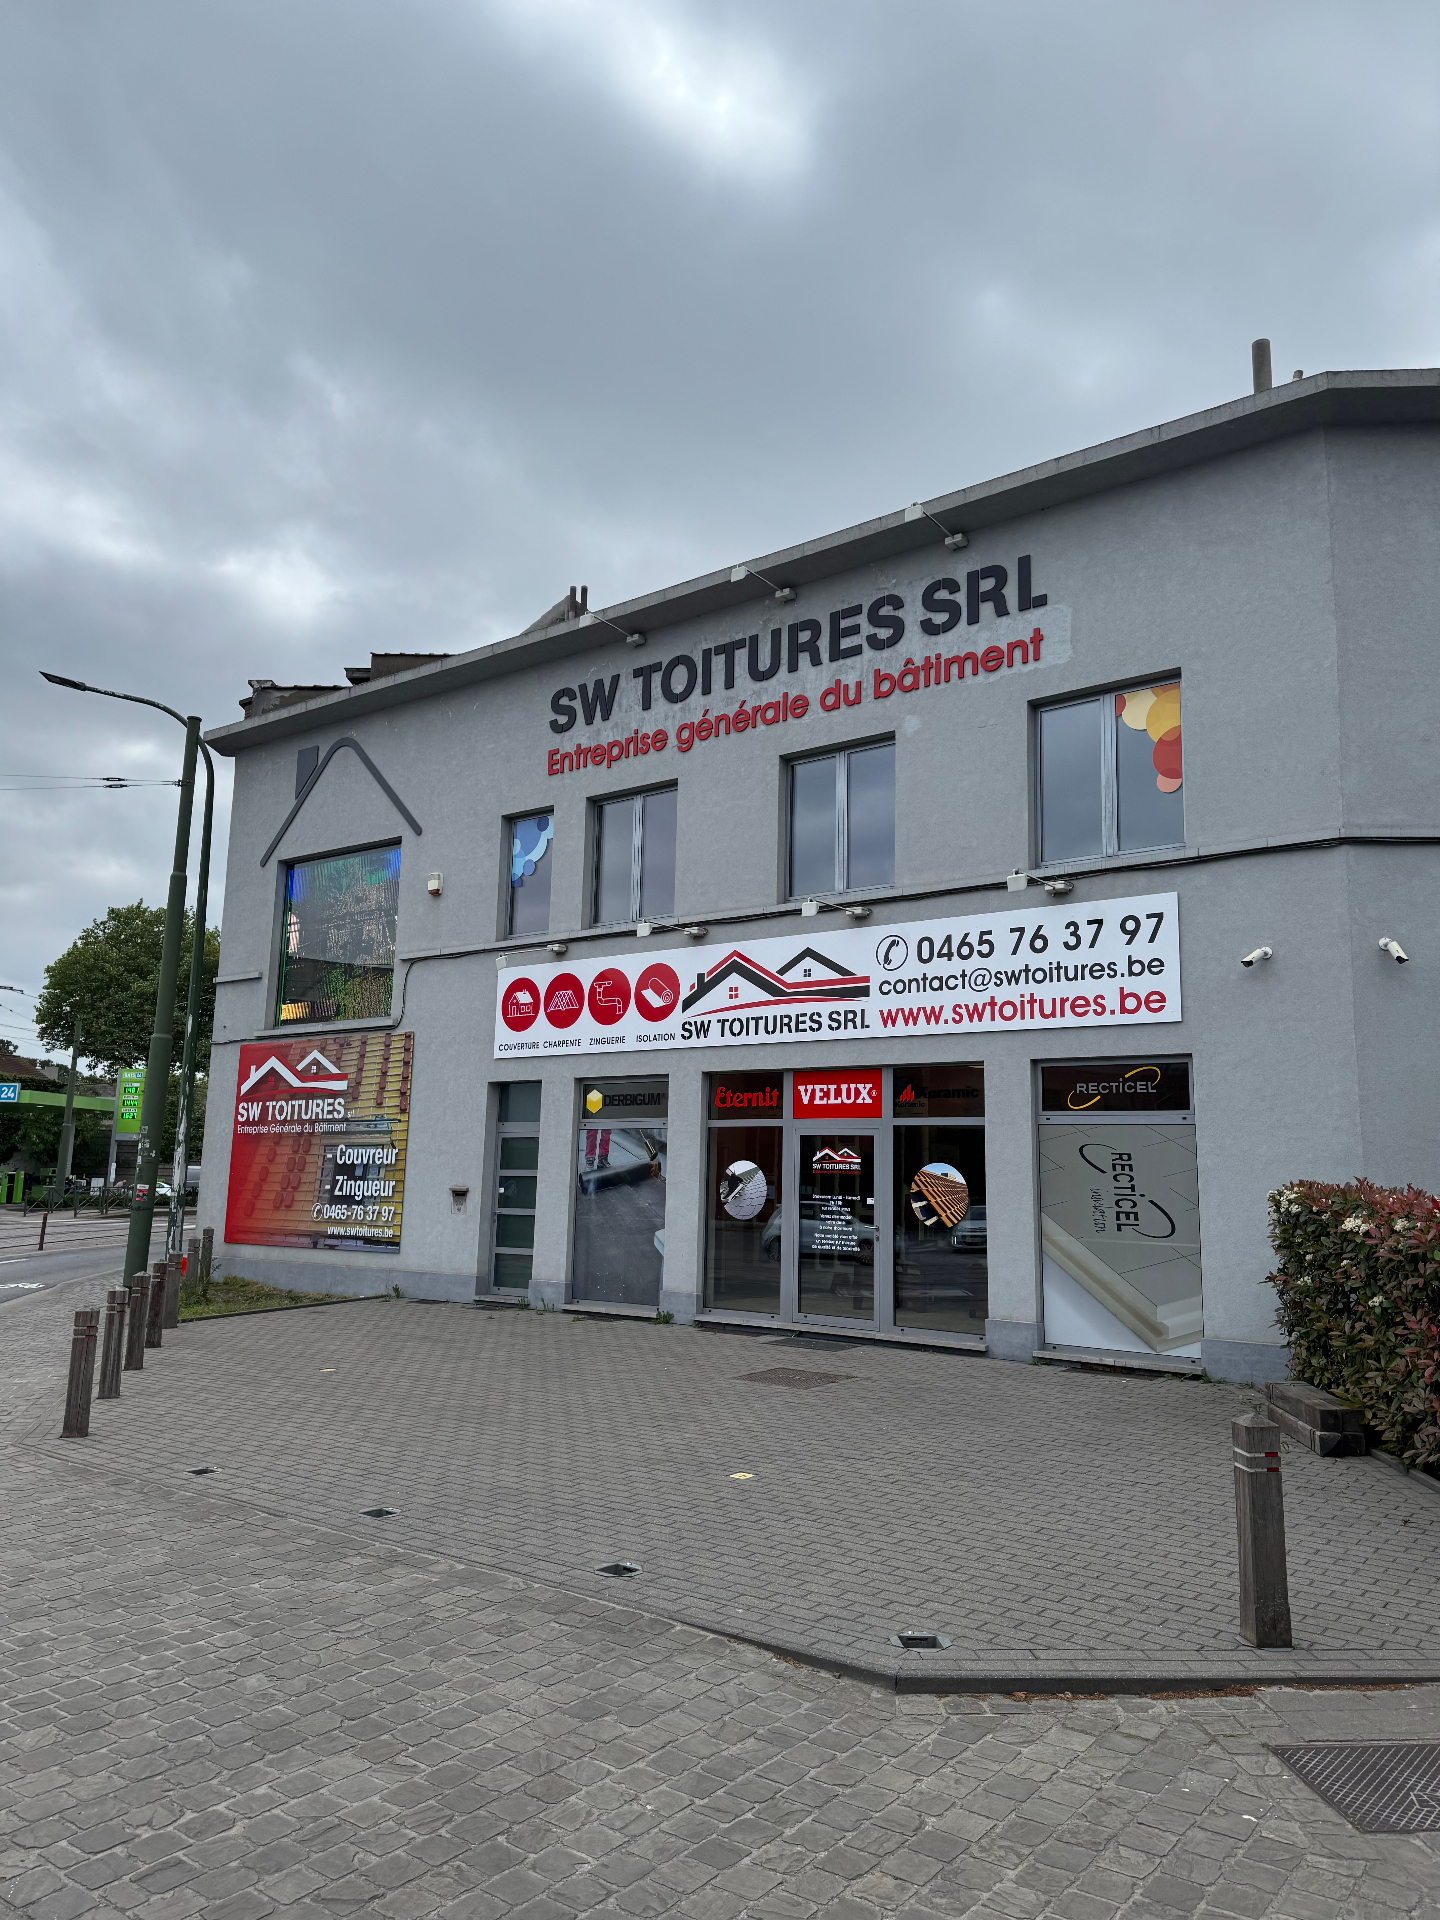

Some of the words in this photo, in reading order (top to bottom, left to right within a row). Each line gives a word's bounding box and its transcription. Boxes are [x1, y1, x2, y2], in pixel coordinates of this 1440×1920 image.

[548, 673, 620, 734] SW
[632, 593, 906, 711] TOITURES
[919, 554, 1048, 636] SRL
[547, 729, 668, 776] Entreprise
[675, 692, 810, 754] générale
[819, 678, 862, 712] du
[873, 627, 1044, 699] bâtiment
[916, 929, 995, 965] 0465
[1009, 924, 1049, 956] 76
[1062, 918, 1104, 951] 37
[1119, 911, 1164, 946] 97
[878, 954, 1165, 996] contact@swtoitures.be
[879, 986, 1167, 1029] www.swtoitures.be
[680, 1020, 712, 1041] SW
[716, 1012, 824, 1038] TOITURES
[827, 1009, 870, 1031] SRL
[498, 1041, 540, 1052] COUVERTURE
[543, 1038, 582, 1049] CHARPENTE
[588, 1035, 626, 1046] ZINGUERIE
[636, 1032, 676, 1043] ISOLATION
[1, 1087, 14, 1098] 24
[714, 1086, 779, 1108] Eternit
[915, 1086, 979, 1098] Koramic
[237, 1102, 262, 1122] SW
[266, 1098, 345, 1120] TOITURES
[237, 1124, 268, 1135] Entreprise
[269, 1123, 301, 1133] Générale
[303, 1123, 313, 1133] du
[314, 1122, 346, 1133] Bâtiment
[336, 1144, 398, 1165] Couvreur
[334, 1175, 395, 1200] Zingueur
[323, 1205, 363, 1221] 0465-76
[366, 1206, 379, 1221] 37
[381, 1206, 394, 1221] 97
[327, 1224, 393, 1238] www.swtoitures.be
